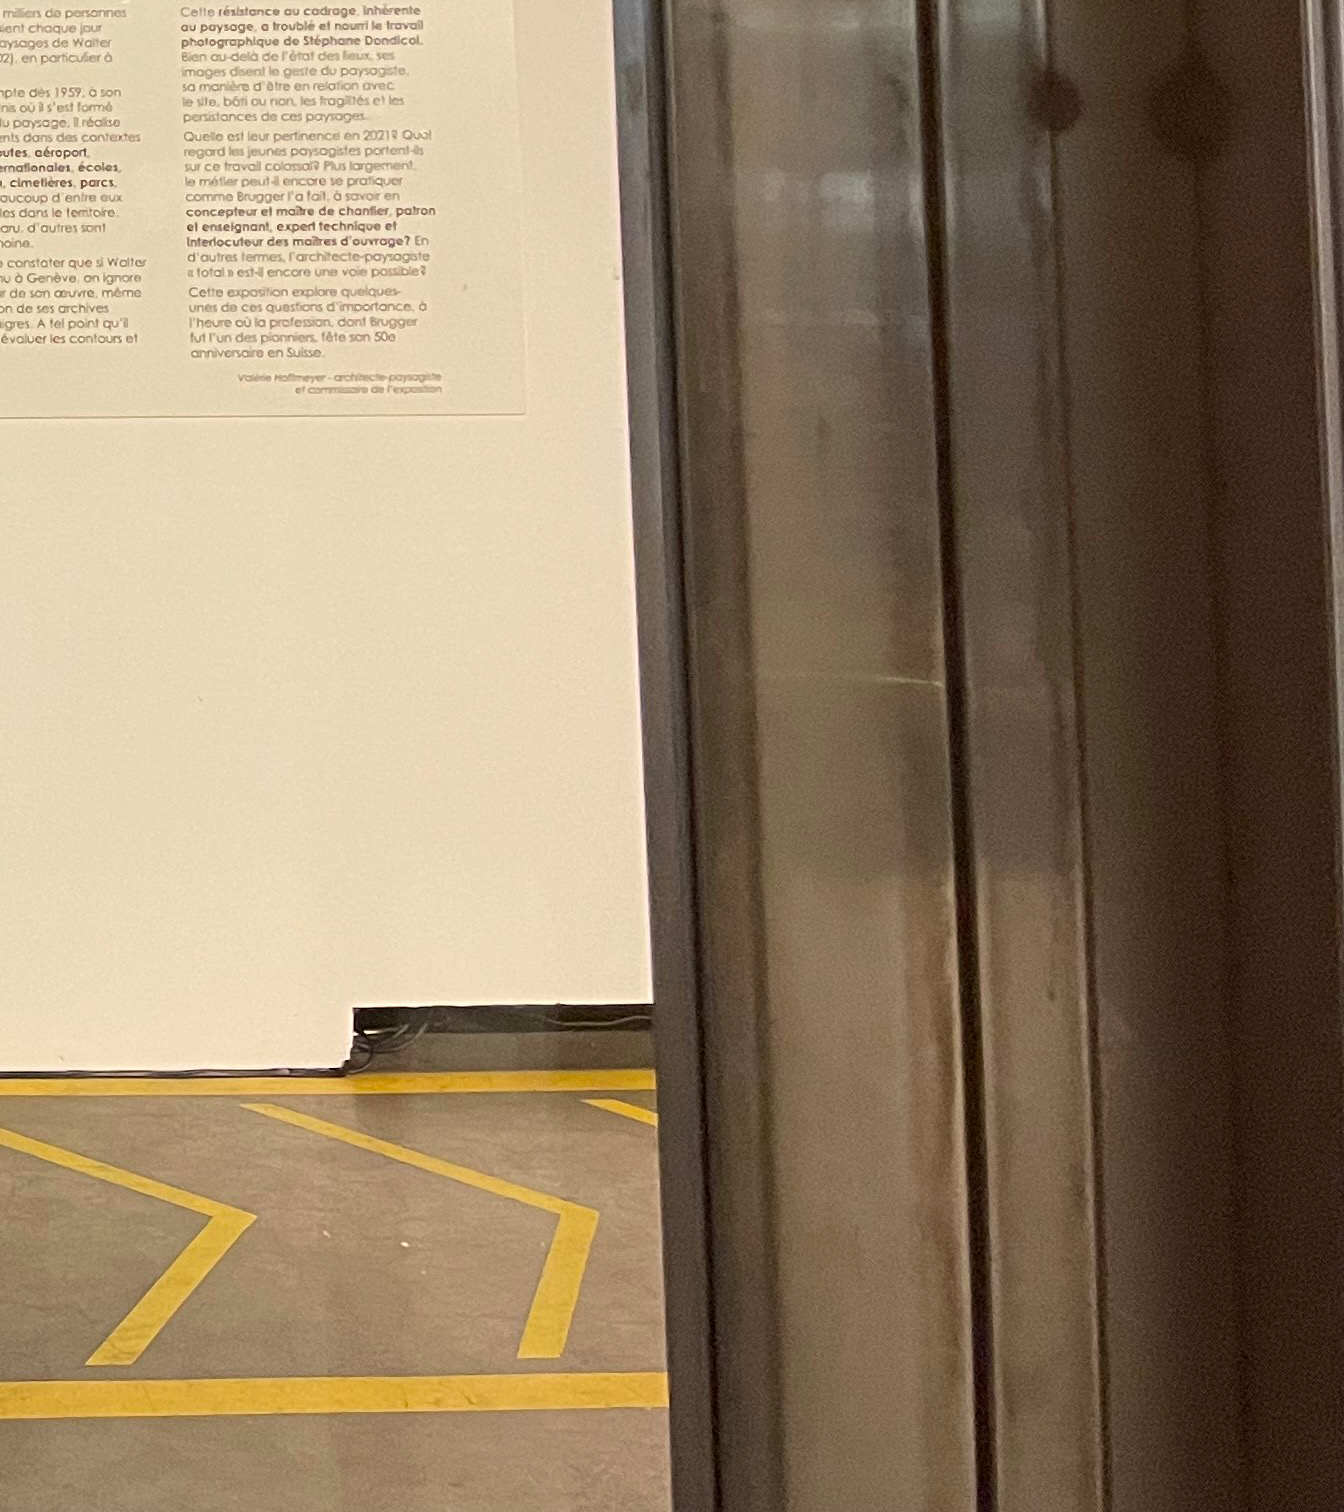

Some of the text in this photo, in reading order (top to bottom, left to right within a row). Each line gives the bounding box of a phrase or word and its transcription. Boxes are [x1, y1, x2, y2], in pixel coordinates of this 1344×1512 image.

[45, 6, 62, 19] de
[65, 8, 127, 20] personnes
[218, 4, 422, 18] résistance au inhérente
[28, 21, 78, 35] chaque
[181, 19, 424, 33] au a troublé et le travail
[52, 36, 70, 49] de
[73, 36, 112, 48] Walter
[181, 35, 362, 49] photographique de Stéphane
[21, 54, 38, 64] en
[181, 50, 280, 63] Bien au-delà de
[320, 65, 338, 77] du
[29, 86, 51, 98] dès
[89, 85, 98, 98] à
[100, 88, 122, 98] son
[182, 80, 250, 93] sa manière
[77, 101, 114, 113] formé
[82, 116, 121, 128] réalise
[183, 111, 303, 125] persistances de ces
[23, 131, 54, 144] dans
[56, 131, 79, 143] des
[81, 131, 141, 143] contextes
[184, 130, 361, 144] Quelle est en
[184, 144, 362, 159] regard paysagistes
[185, 159, 347, 173] sur ce travail Plus
[185, 174, 404, 188] le métier encore se pratiquer
[100, 193, 123, 203] eux
[185, 190, 343, 204] comme Brugger à
[19, 206, 49, 219] dans
[52, 206, 63, 219] le
[186, 204, 437, 220] concepteur et maître de patron
[81, 221, 107, 234] sont
[187, 219, 398, 234] et expert technique et
[187, 234, 429, 249] interlocuteur des maîtres d'ouvrage? En
[7, 256, 66, 269] constater
[68, 259, 93, 270] que
[107, 256, 147, 269] Walter
[197, 265, 368, 278] total encore voie
[15, 272, 24, 284] à
[84, 274, 100, 284] on
[103, 271, 142, 286] ignore
[9, 287, 27, 299] de
[30, 289, 51, 299] son
[102, 286, 142, 299] même
[189, 285, 289, 300] Cette exposition
[16, 302, 34, 315] de
[37, 305, 55, 315] ses
[58, 302, 110, 315] archives
[189, 300, 324, 315] unes de ces questions
[37, 317, 47, 330] A
[50, 317, 65, 330] tel
[68, 317, 100, 331] point
[255, 315, 367, 328] la dont
[1, 332, 48, 345] évaluer
[50, 332, 67, 345] les
[69, 332, 123, 345] contours
[126, 332, 138, 345] et
[190, 330, 397, 343] fut des fête 50e
[191, 347, 285, 359] anniversaire en
